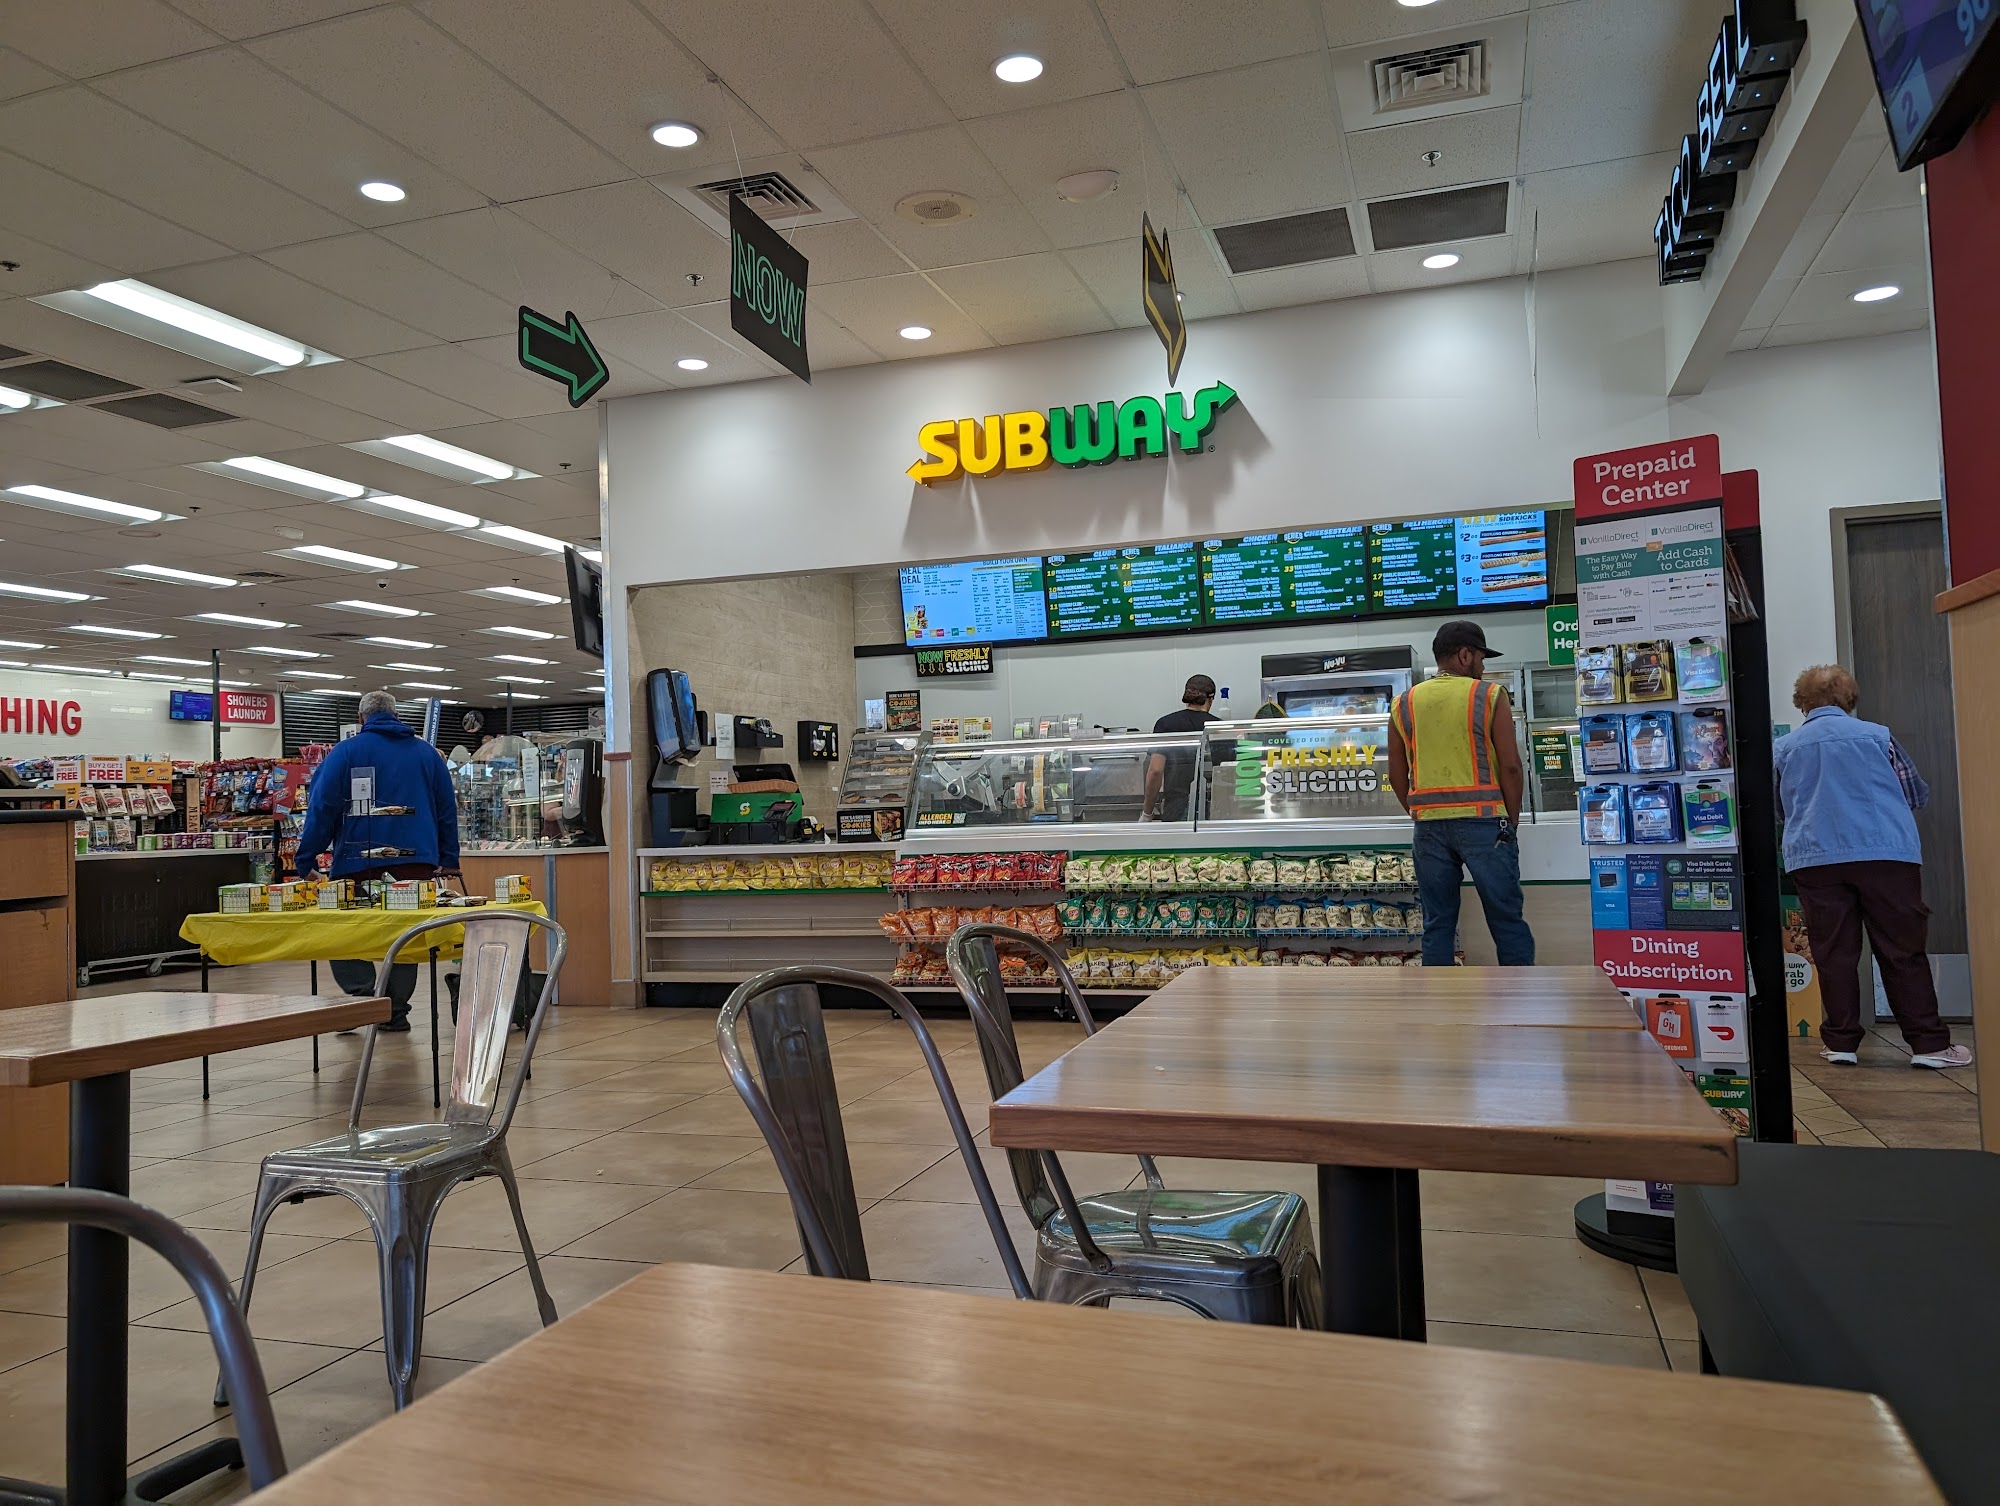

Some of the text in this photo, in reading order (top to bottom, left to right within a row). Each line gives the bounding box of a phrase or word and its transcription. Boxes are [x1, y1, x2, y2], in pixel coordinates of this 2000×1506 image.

[732, 228, 804, 347] NOW
[905, 380, 1237, 486] SUBWAY
[1593, 447, 1696, 483] Prepaid
[1602, 479, 1691, 506] Center
[1461, 514, 1497, 525] NEW
[1499, 514, 1537, 522] SIDEKICKS
[1304, 526, 1363, 537] CHEESESTEAKS
[1372, 524, 1392, 532] SERIES
[1658, 522, 1713, 535] VanillaDirect
[1243, 534, 1278, 542] CHICKEN
[1284, 532, 1303, 540] SERIES
[1588, 532, 1638, 544] VanillaDirect
[1154, 542, 1193, 551] ITALIANOS
[1585, 552, 1637, 565] The Easy Way
[1657, 546, 1713, 561] Add Cash
[1601, 564, 1615, 572] Pay
[1661, 557, 1709, 570] to Cards
[901, 567, 921, 575] MEAL
[1593, 572, 1609, 580] with
[902, 575, 921, 584] DEAL
[917, 647, 990, 663] NOW FRESHLY
[946, 660, 989, 673] SLICING
[227, 695, 267, 707] SHOWERS
[228, 708, 266, 720] LAUNDRY
[1267, 745, 1377, 767] FRESHLY
[1235, 740, 1263, 796] NOW
[56, 772, 78, 780] FREE
[88, 770, 123, 780] FREE
[1266, 769, 1377, 793] SLICING
[919, 813, 953, 821] ALLERGEN
[1631, 937, 1699, 958] Dining
[1603, 960, 1733, 982] Subscription
[1790, 978, 1805, 987] go
[1703, 1090, 1745, 1098] SUBWAY
